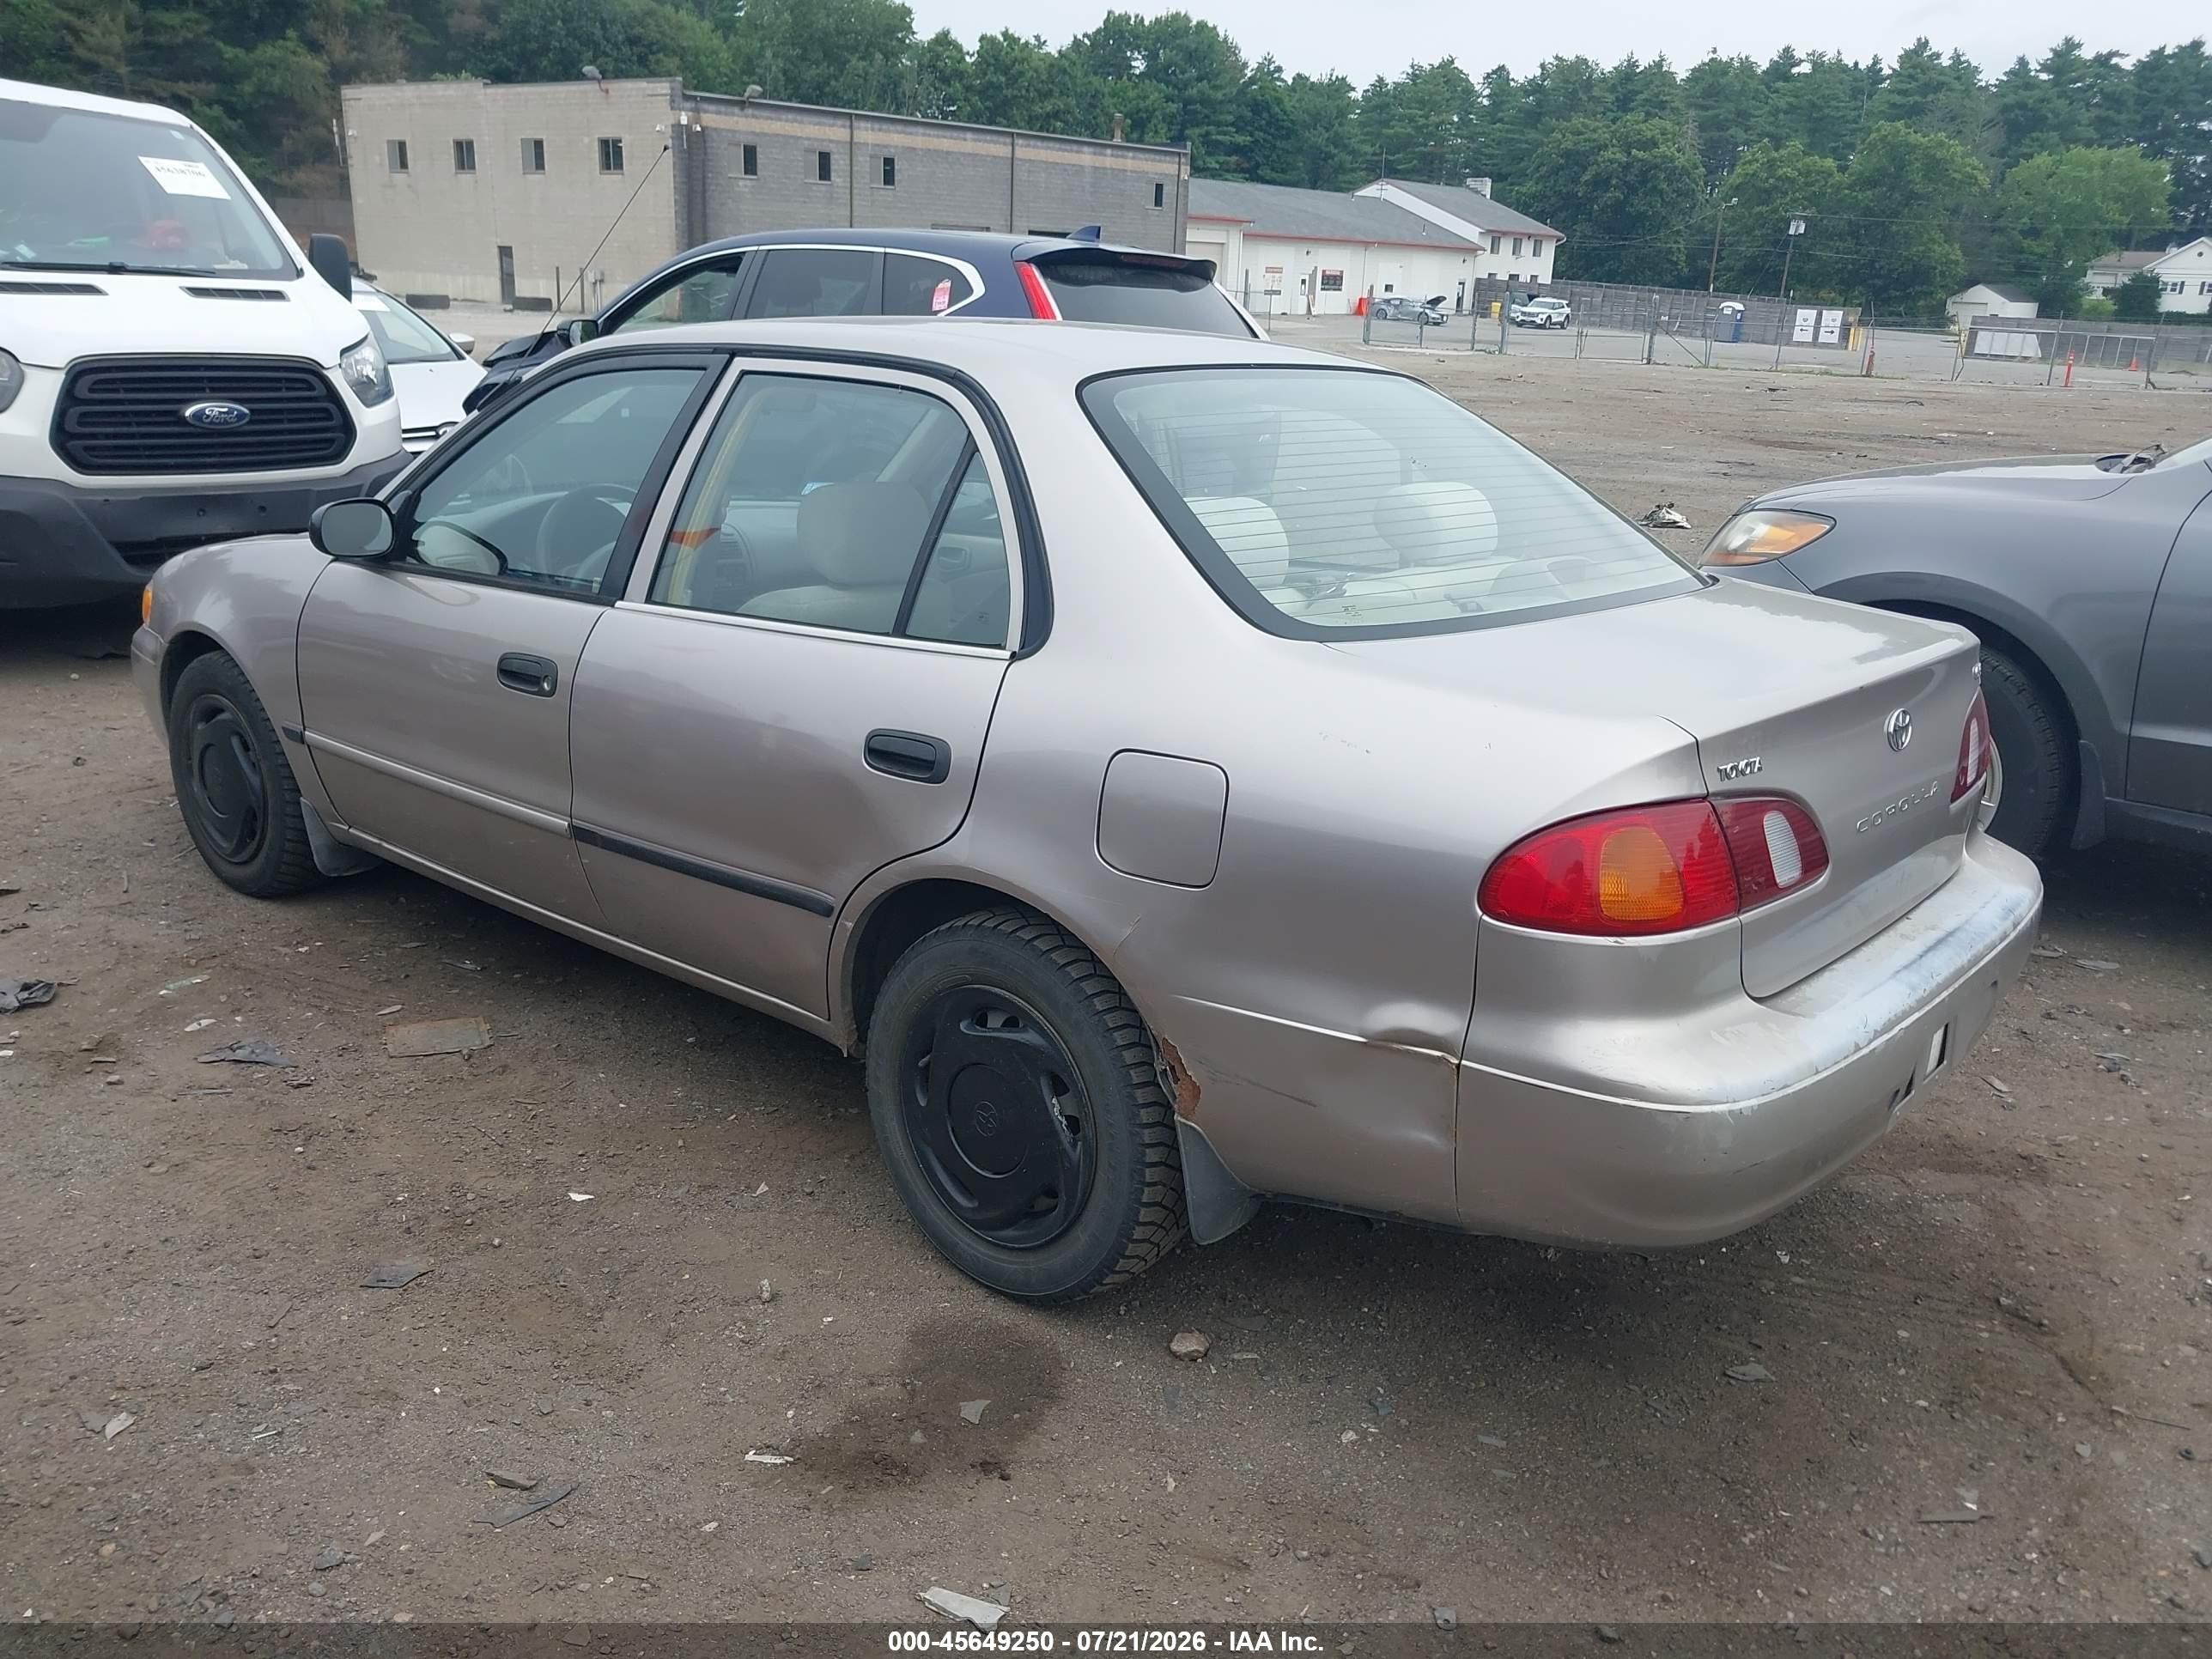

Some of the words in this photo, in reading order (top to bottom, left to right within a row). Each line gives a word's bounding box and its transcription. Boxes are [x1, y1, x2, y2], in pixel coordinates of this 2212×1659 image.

[203, 407, 238, 422] Ford
[1717, 757, 1762, 781] TOYOTA
[1856, 781, 1938, 832] COROLLA
